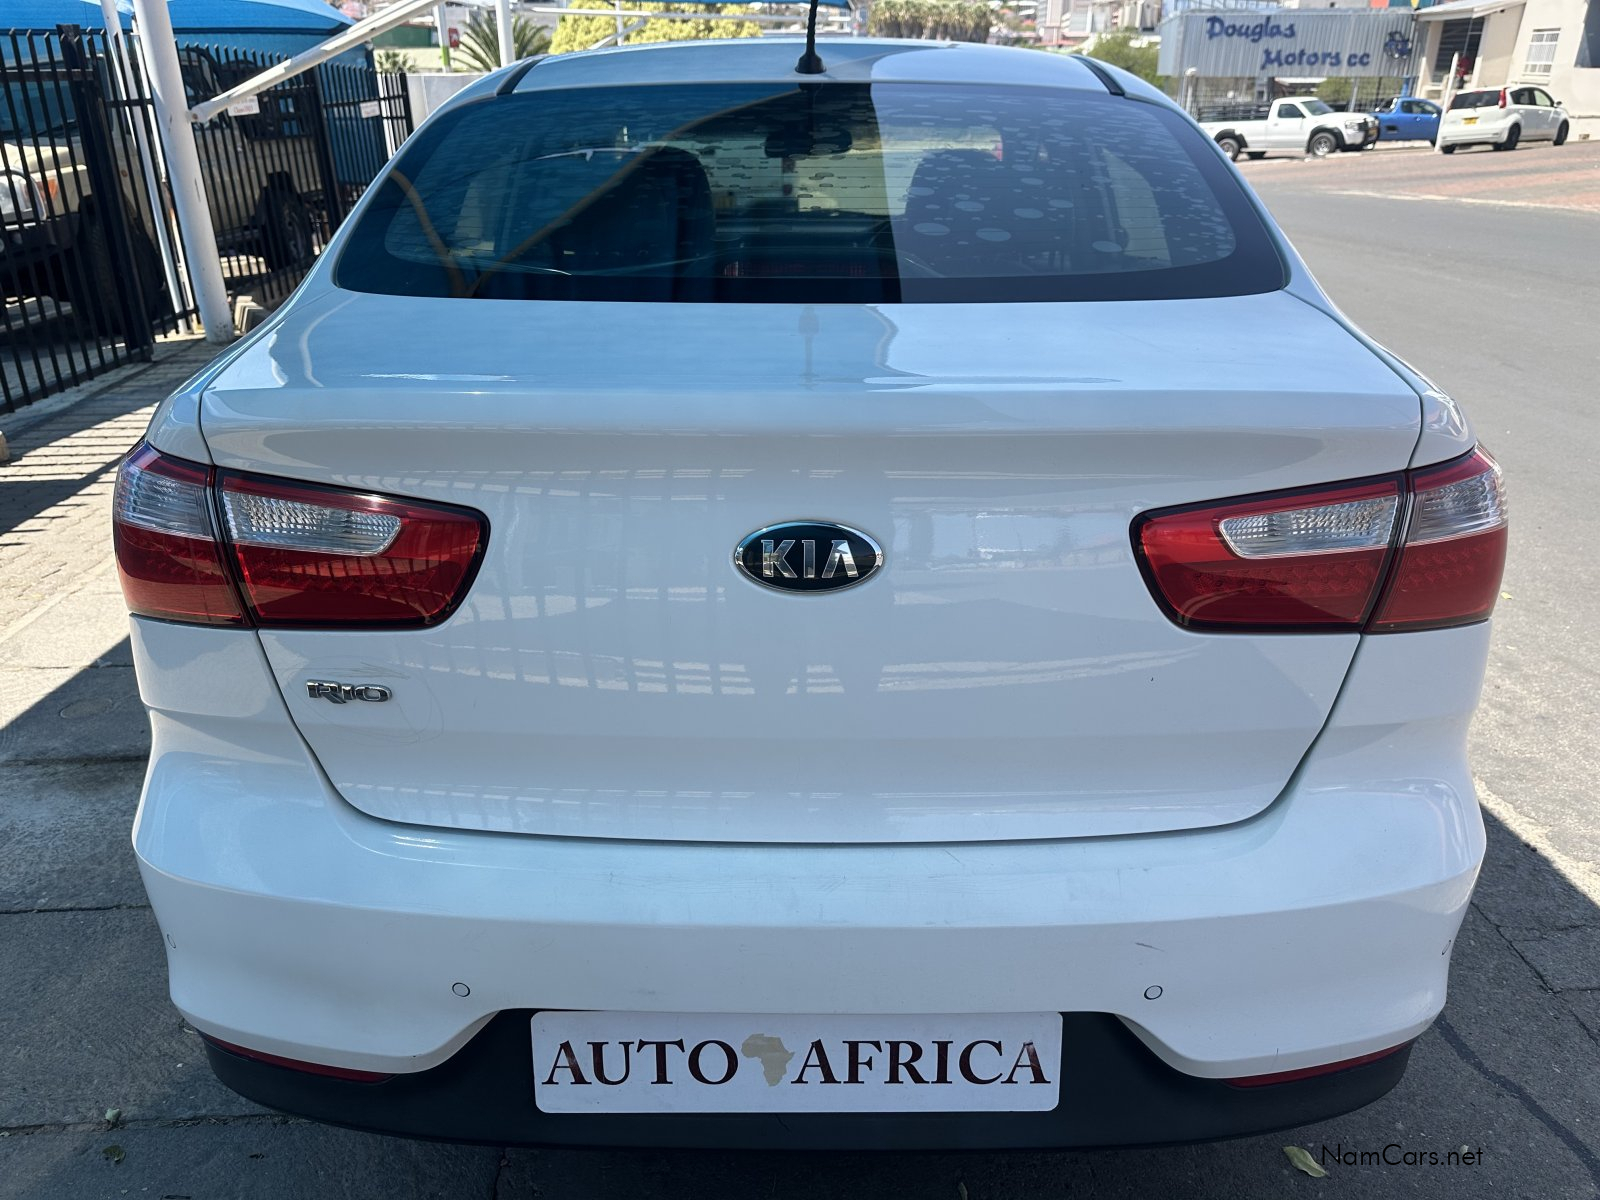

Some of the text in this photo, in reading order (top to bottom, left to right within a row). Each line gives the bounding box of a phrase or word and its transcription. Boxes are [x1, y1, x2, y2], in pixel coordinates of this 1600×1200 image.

[1206, 16, 1295, 42] Douglas
[1261, 48, 1341, 70] Motors
[760, 539, 859, 578] KIA
[541, 1038, 1051, 1085] AUTO AFRICA
